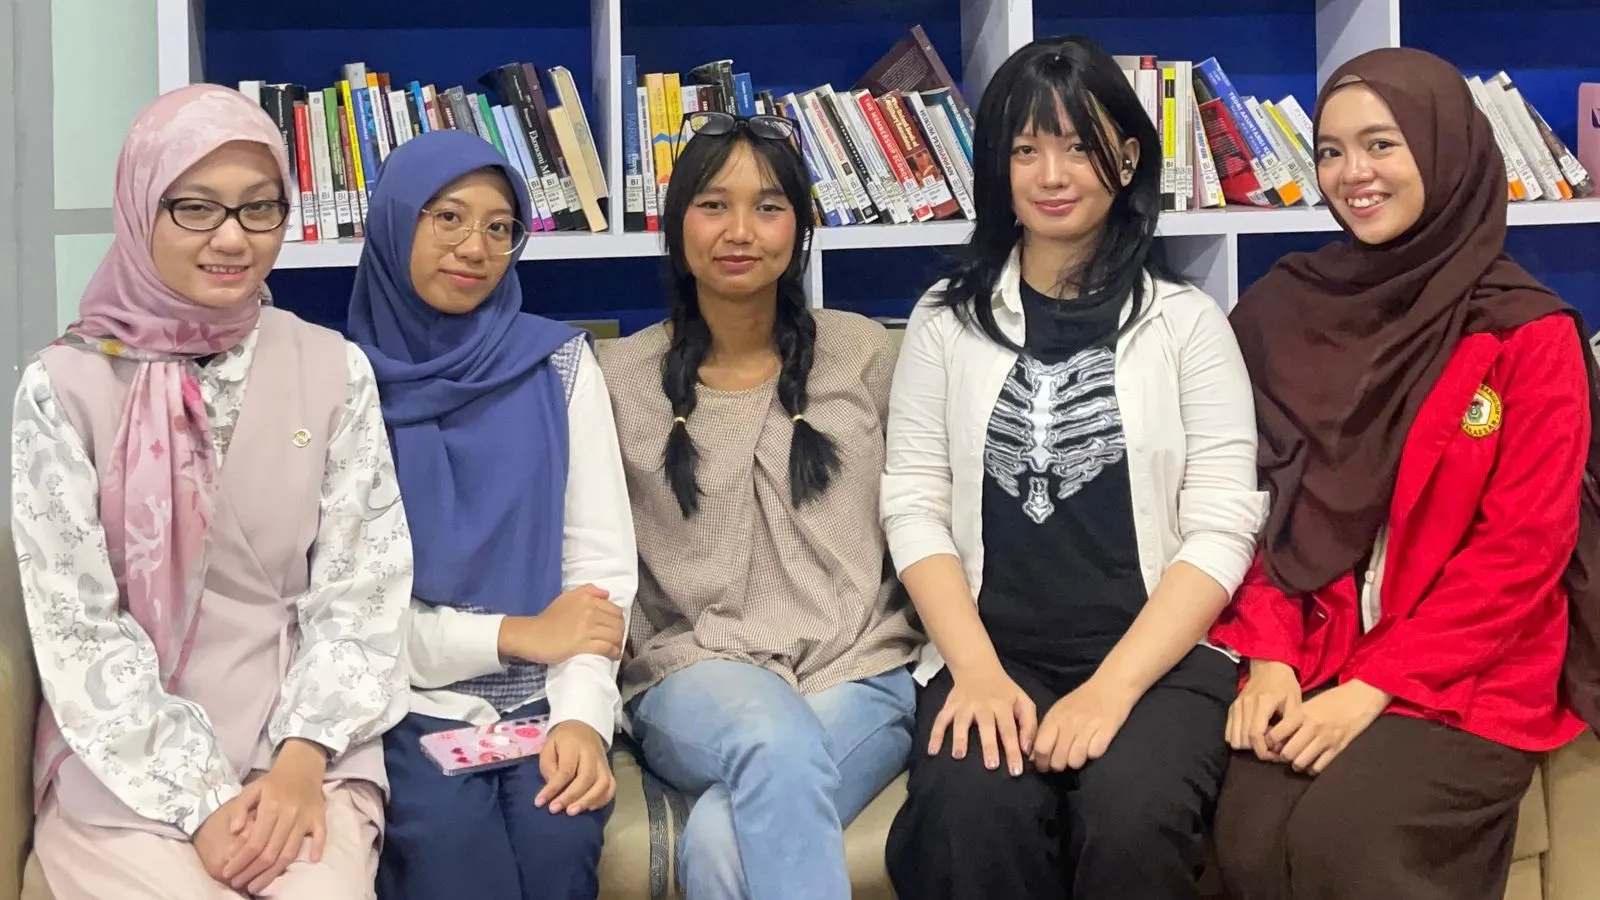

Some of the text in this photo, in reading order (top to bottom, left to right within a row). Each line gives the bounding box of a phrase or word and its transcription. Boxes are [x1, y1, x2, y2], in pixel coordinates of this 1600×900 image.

[863, 97, 874, 111] THE
[870, 111, 896, 154] MEMBERSHIP
[918, 109, 955, 176] HUKUM PERBANKAN
[1228, 91, 1243, 110] TEORI
[1240, 110, 1265, 146] AKUNTANSI
[527, 127, 547, 166] Ekonomi
[304, 193, 312, 201] BI
